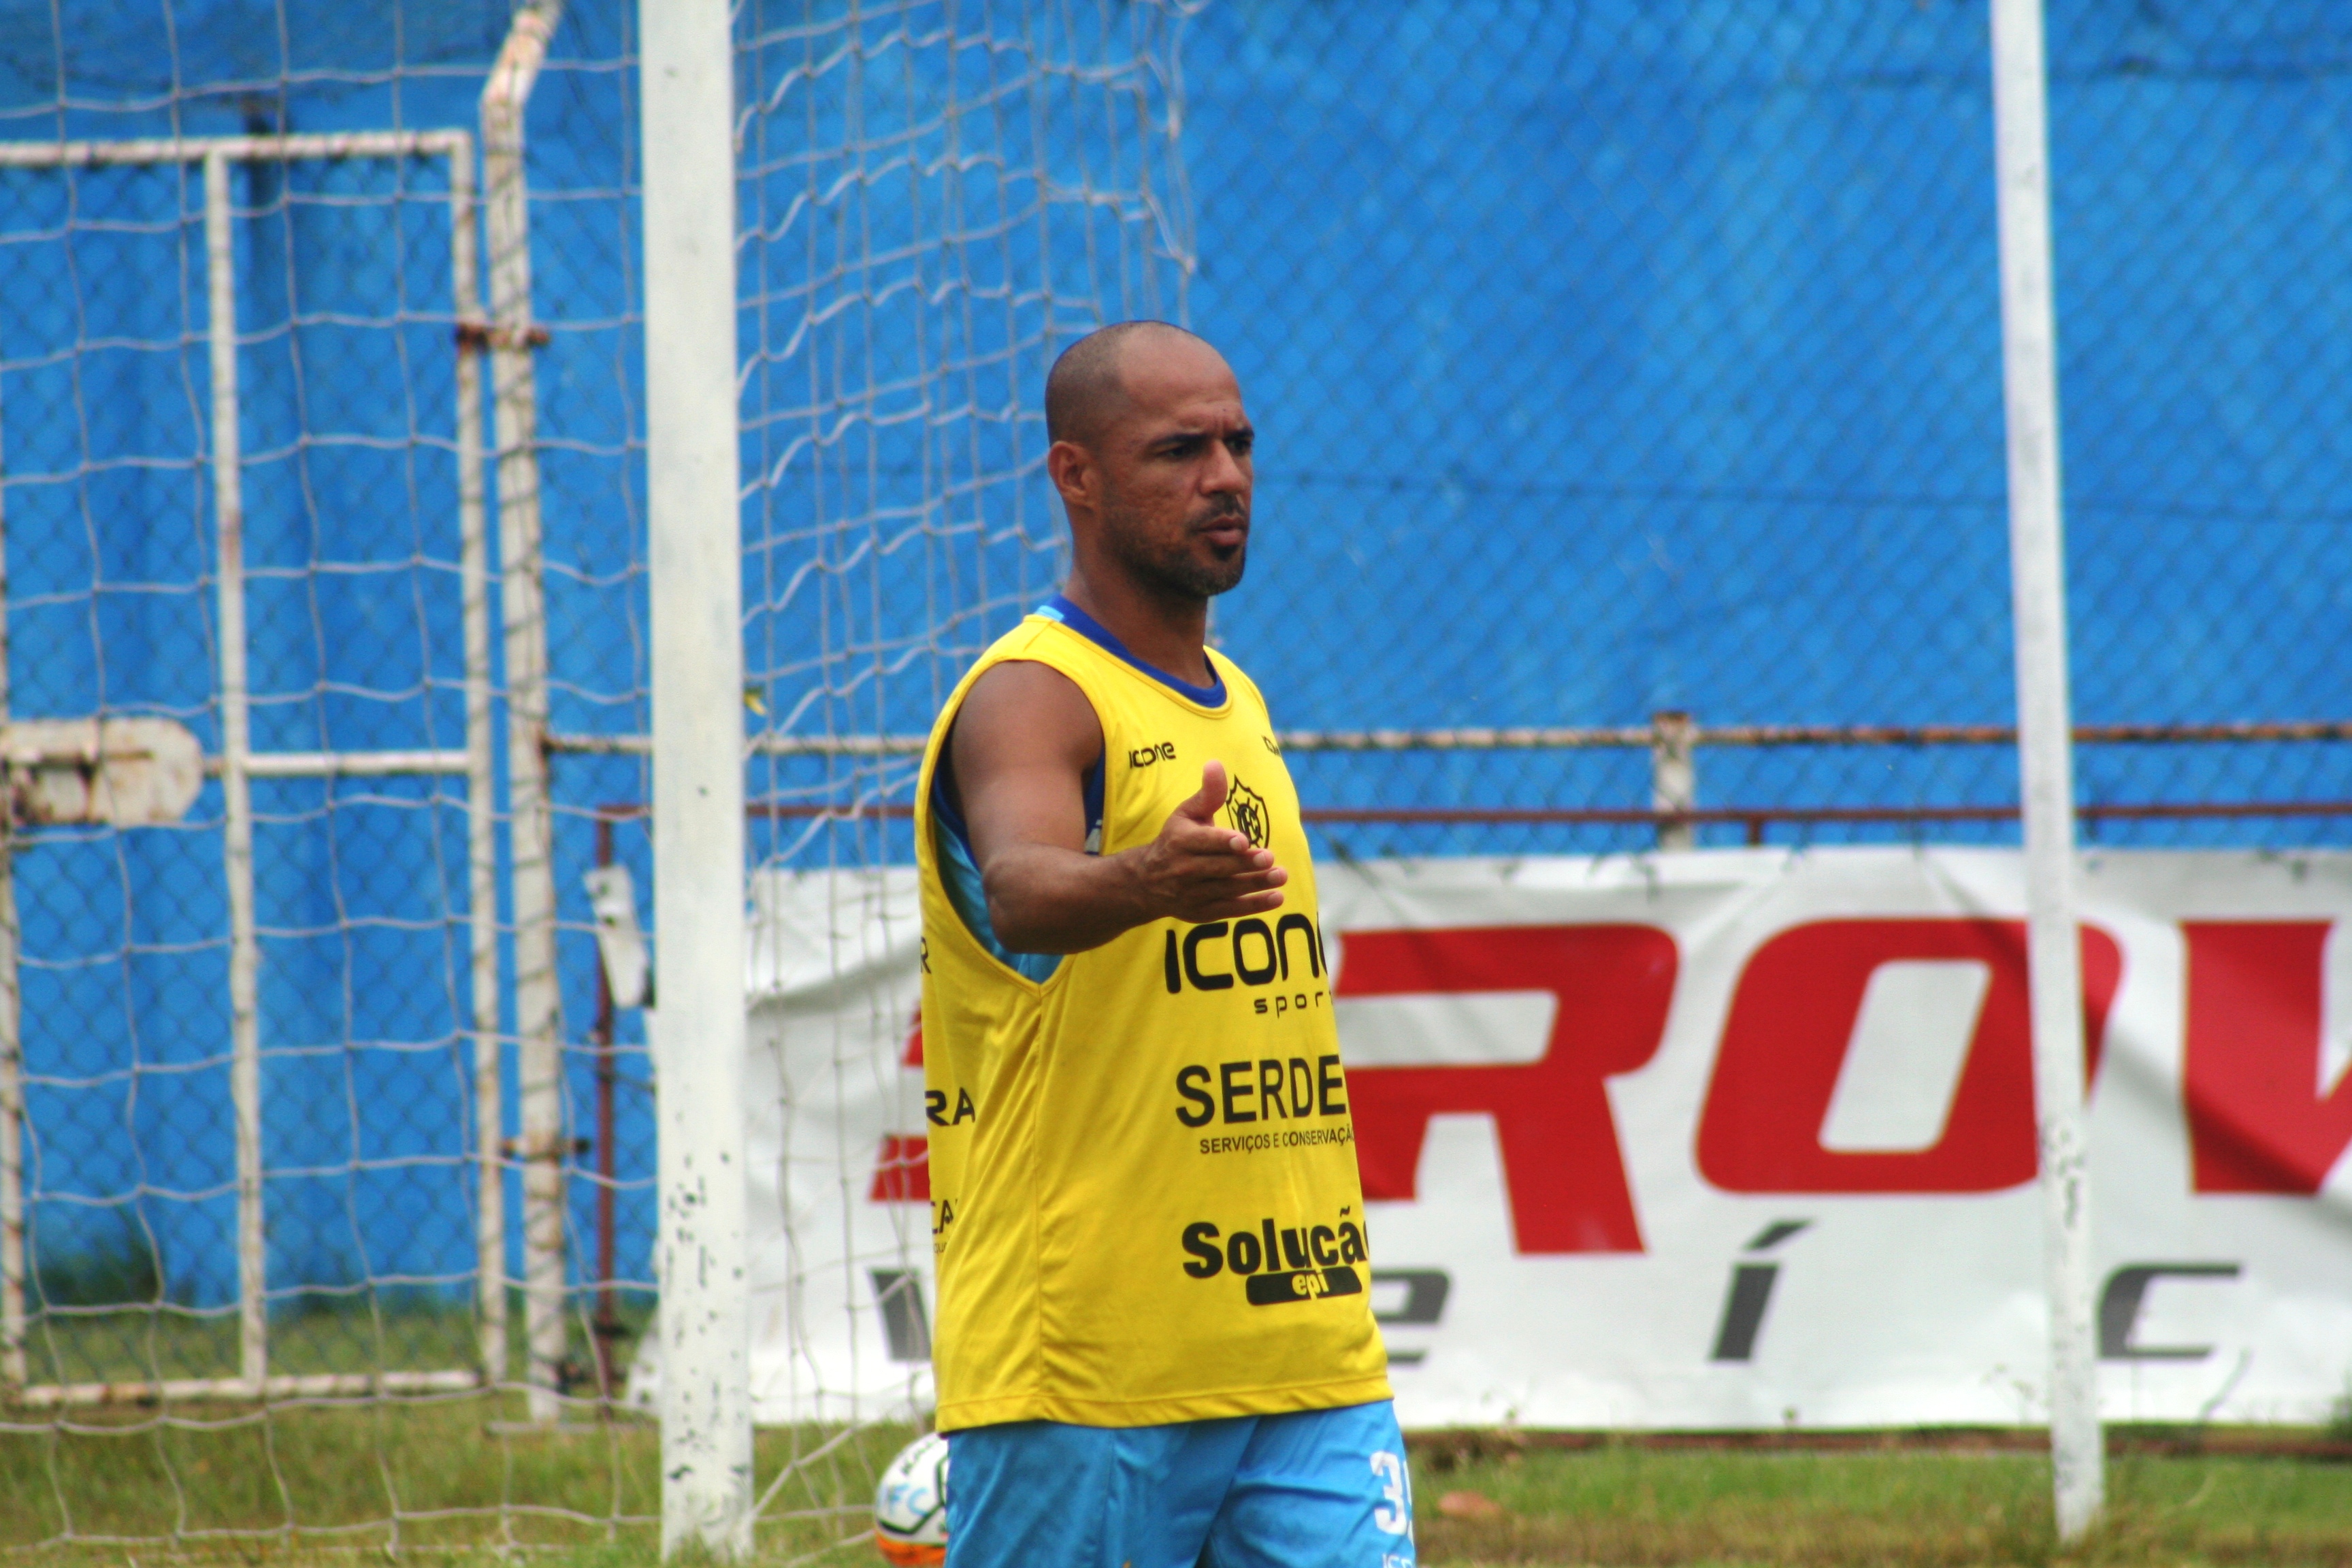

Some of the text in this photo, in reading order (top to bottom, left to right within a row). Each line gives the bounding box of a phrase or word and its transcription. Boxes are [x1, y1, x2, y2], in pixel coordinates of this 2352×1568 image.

[1254, 991, 1333, 1019] spor
[1200, 1133, 1271, 1154] SERVIÇOS
[1273, 1132, 1279, 1148] E
[1370, 1451, 1414, 1548] 3
